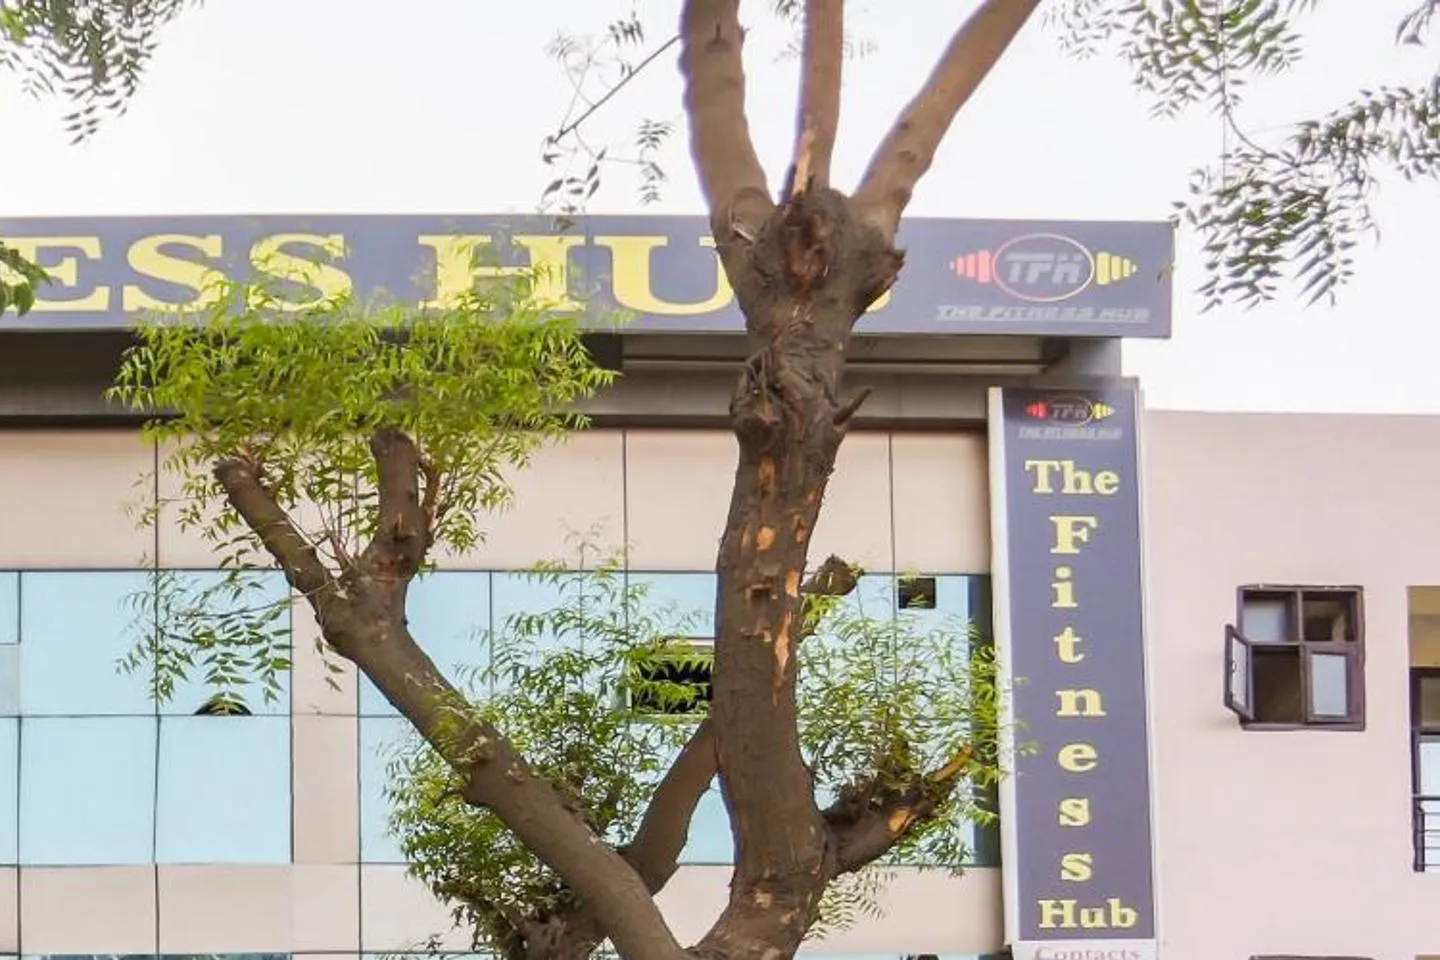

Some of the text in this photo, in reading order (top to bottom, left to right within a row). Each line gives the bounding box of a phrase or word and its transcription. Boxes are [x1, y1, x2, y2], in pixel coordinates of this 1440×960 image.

[417, 234, 892, 316] HU
[1025, 460, 1120, 494] The
[1038, 898, 1138, 929] Hub
